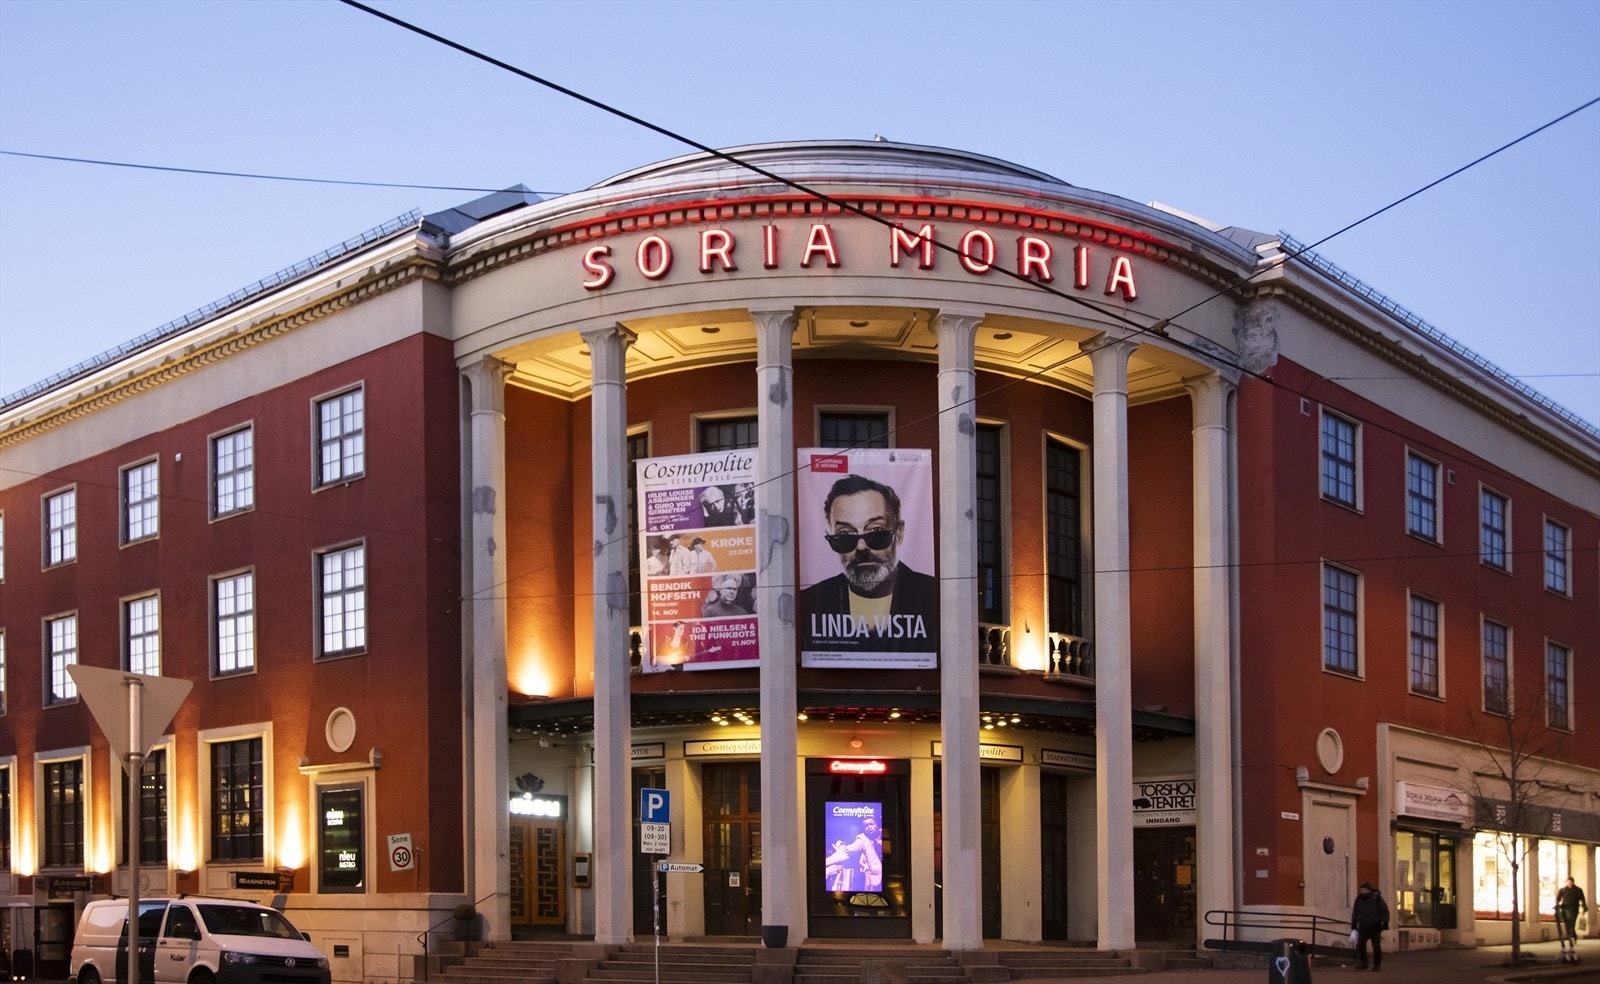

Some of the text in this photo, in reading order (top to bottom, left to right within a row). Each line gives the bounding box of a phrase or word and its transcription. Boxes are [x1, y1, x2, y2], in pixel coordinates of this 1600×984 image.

[582, 223, 1140, 301] SORIA MORIA
[644, 452, 753, 482] Cosmopolite
[670, 474, 731, 485] SCENE OSLO
[647, 489, 695, 499] HILDE LOUISE
[648, 506, 687, 515] GERMETEN
[660, 523, 675, 531] OKT
[711, 536, 753, 548] KROKE
[650, 581, 692, 591] BENDIK
[650, 590, 701, 601] HOFSETH
[709, 623, 747, 632] NIELSEN
[749, 622, 756, 630] &
[811, 613, 928, 639] LINDA VISTA
[689, 630, 756, 641] THE FUNKBOTS
[731, 639, 757, 647] 21.NOV
[702, 741, 761, 753] Cosmopolite
[831, 760, 886, 774] Cosmopolite
[648, 793, 664, 819] P
[1150, 795, 1196, 809] TEATRET
[833, 806, 875, 818] Cosmopolite
[391, 836, 408, 844] Sone
[338, 850, 356, 861] nieu
[395, 851, 408, 863] 30
[670, 864, 698, 872] Automat
